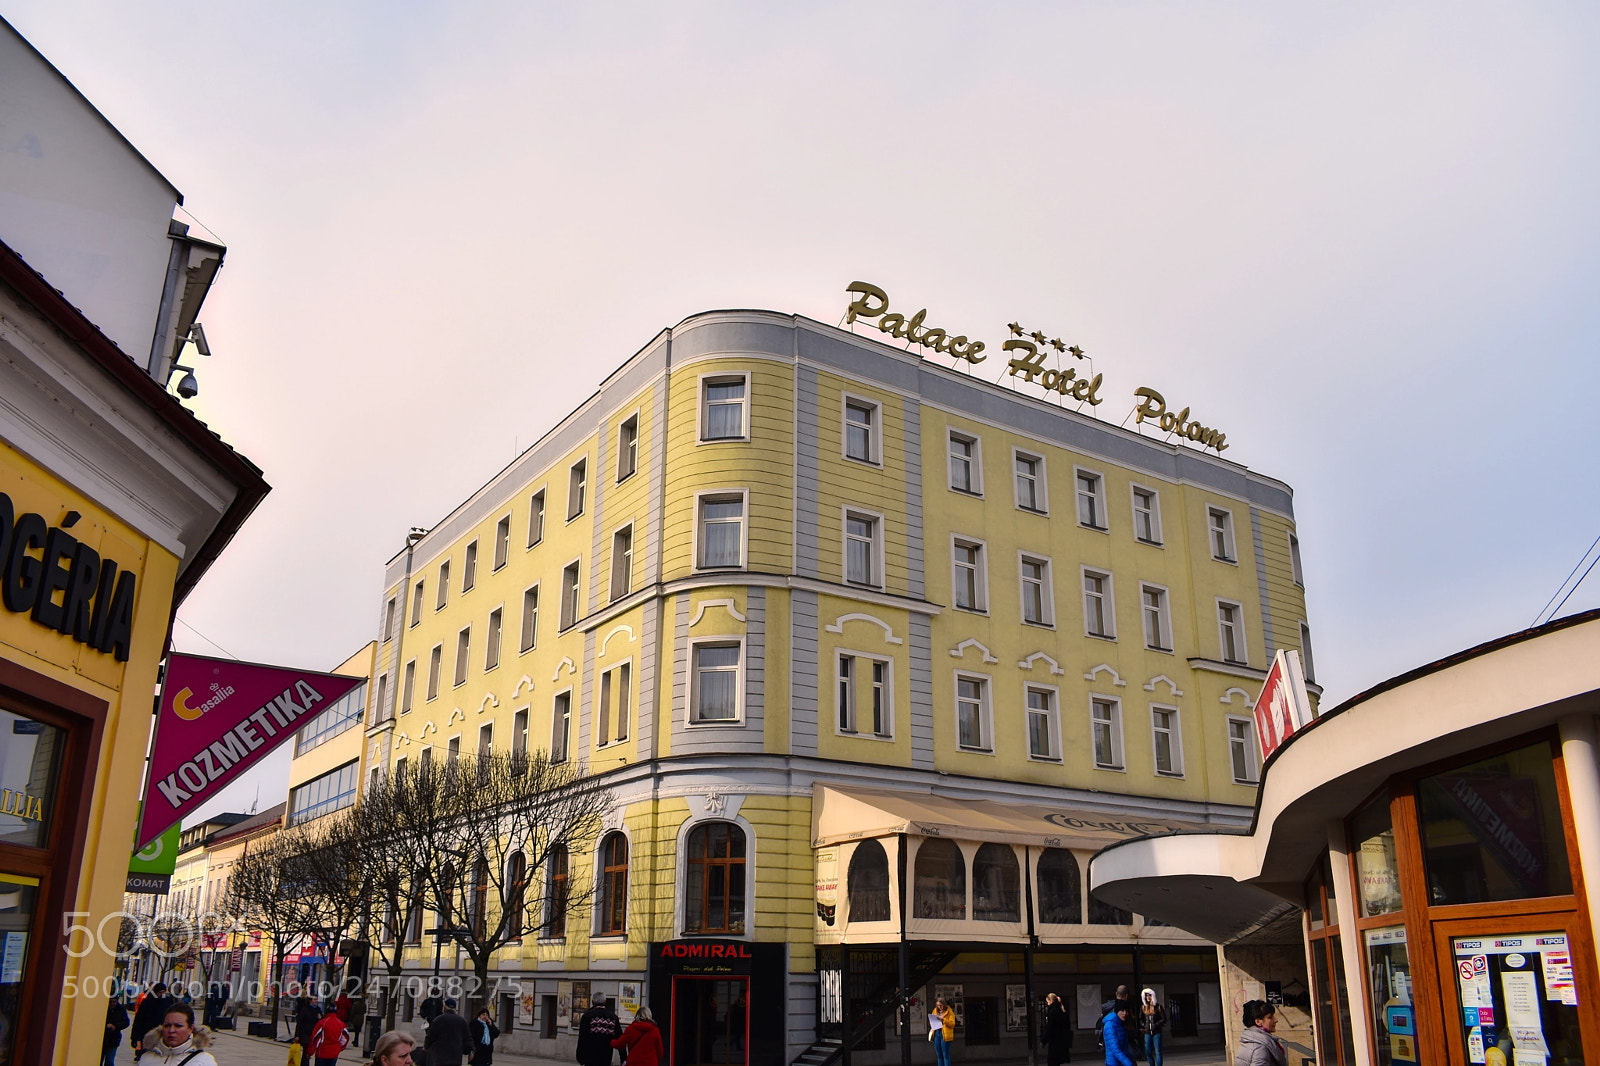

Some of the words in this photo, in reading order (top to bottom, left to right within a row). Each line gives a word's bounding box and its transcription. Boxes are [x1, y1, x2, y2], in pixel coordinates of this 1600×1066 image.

[846, 281, 987, 364] Palace
[1002, 339, 1103, 406] Hotel
[1134, 386, 1229, 451] Polom
[173, 684, 235, 720] Casallia
[156, 679, 324, 809] KOZMETIKA
[660, 944, 752, 958] ADMIRAL
